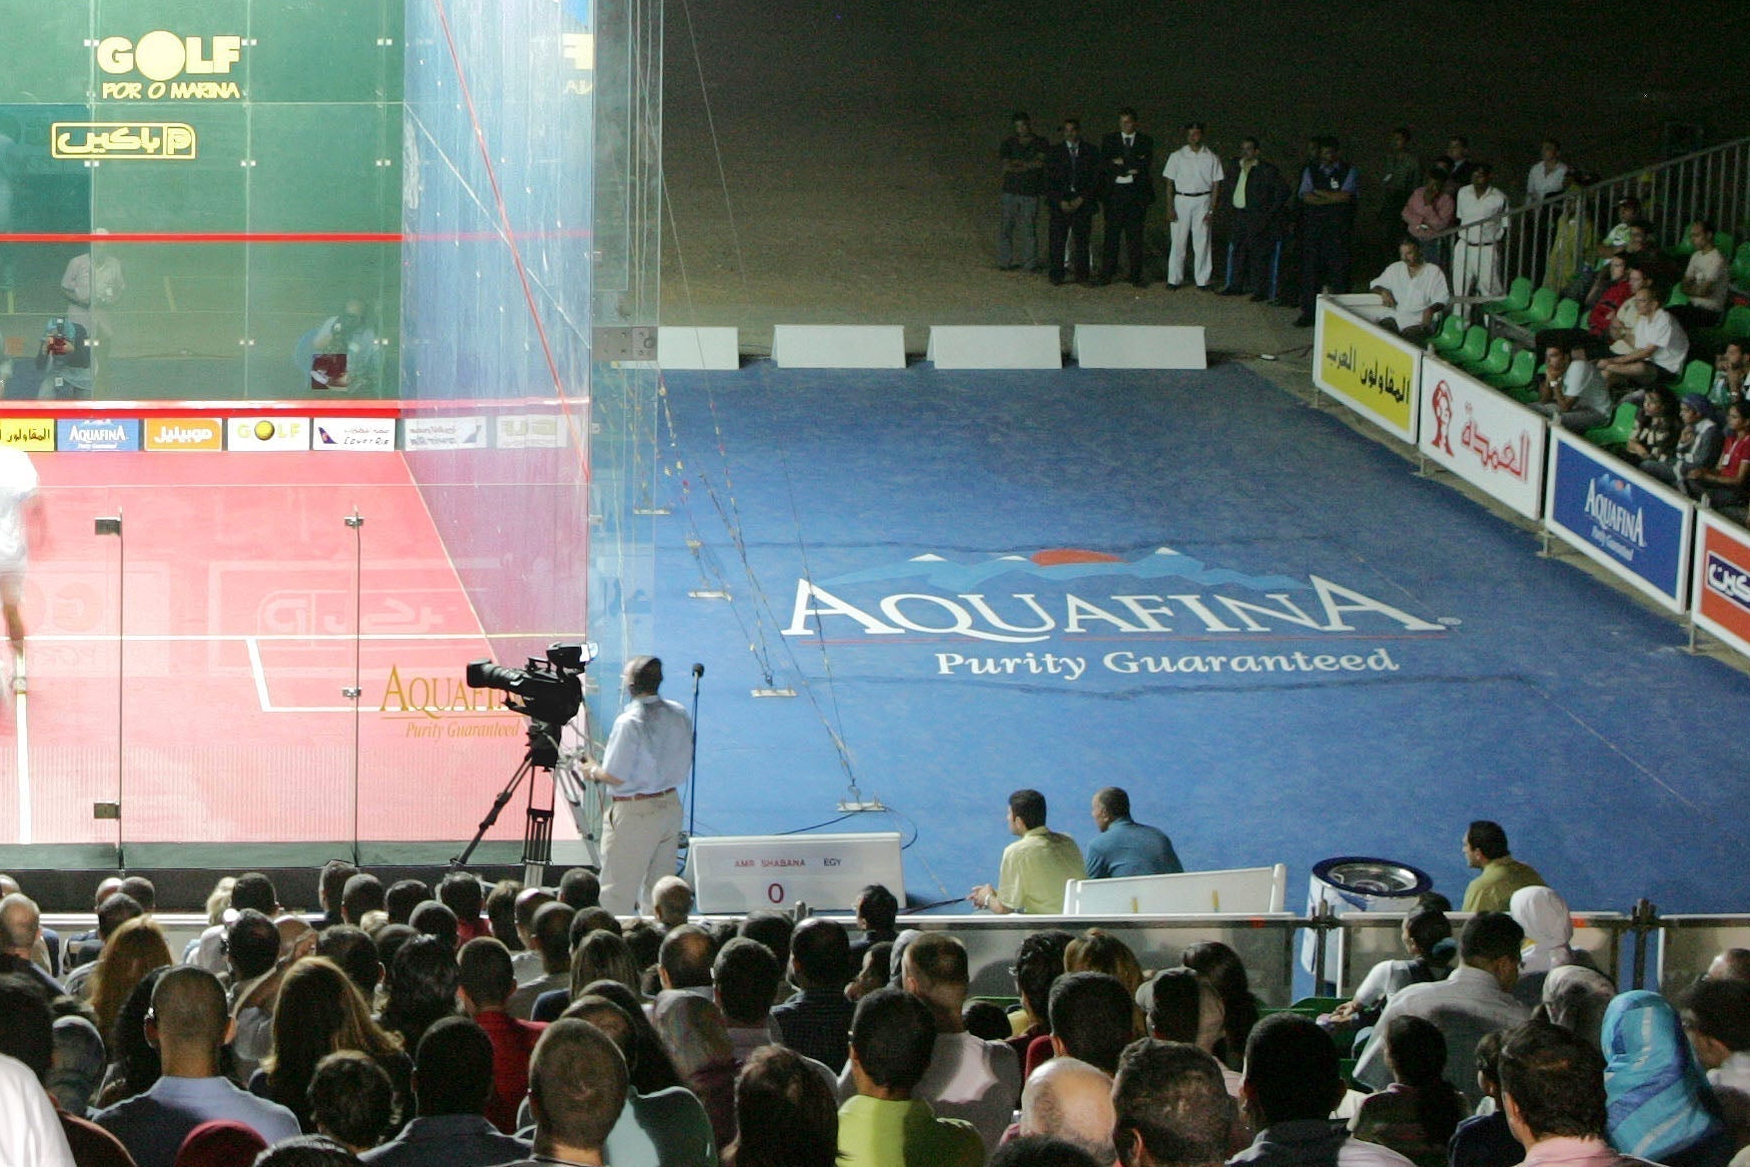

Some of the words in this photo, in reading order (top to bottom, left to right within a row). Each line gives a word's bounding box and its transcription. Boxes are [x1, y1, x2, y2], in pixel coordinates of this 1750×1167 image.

[96, 30, 242, 82] GOLF
[170, 82, 241, 99] MARINA
[1326, 347, 1357, 373] العرب
[1359, 364, 1410, 405] المقاولون
[68, 425, 126, 443] AQUAFINA
[237, 420, 301, 441] GOLF
[1460, 400, 1531, 483] العمدة
[1584, 477, 1648, 548] AQUAFINA
[781, 574, 1446, 642] AQUAFINA
[935, 650, 1087, 681] Purity
[1102, 647, 1400, 674] Guaranteed
[406, 721, 442, 741] Purity
[447, 719, 521, 738] Guaranteed
[734, 859, 755, 868] AMR
[760, 858, 806, 868] SHABANA
[823, 857, 842, 868] EGY
